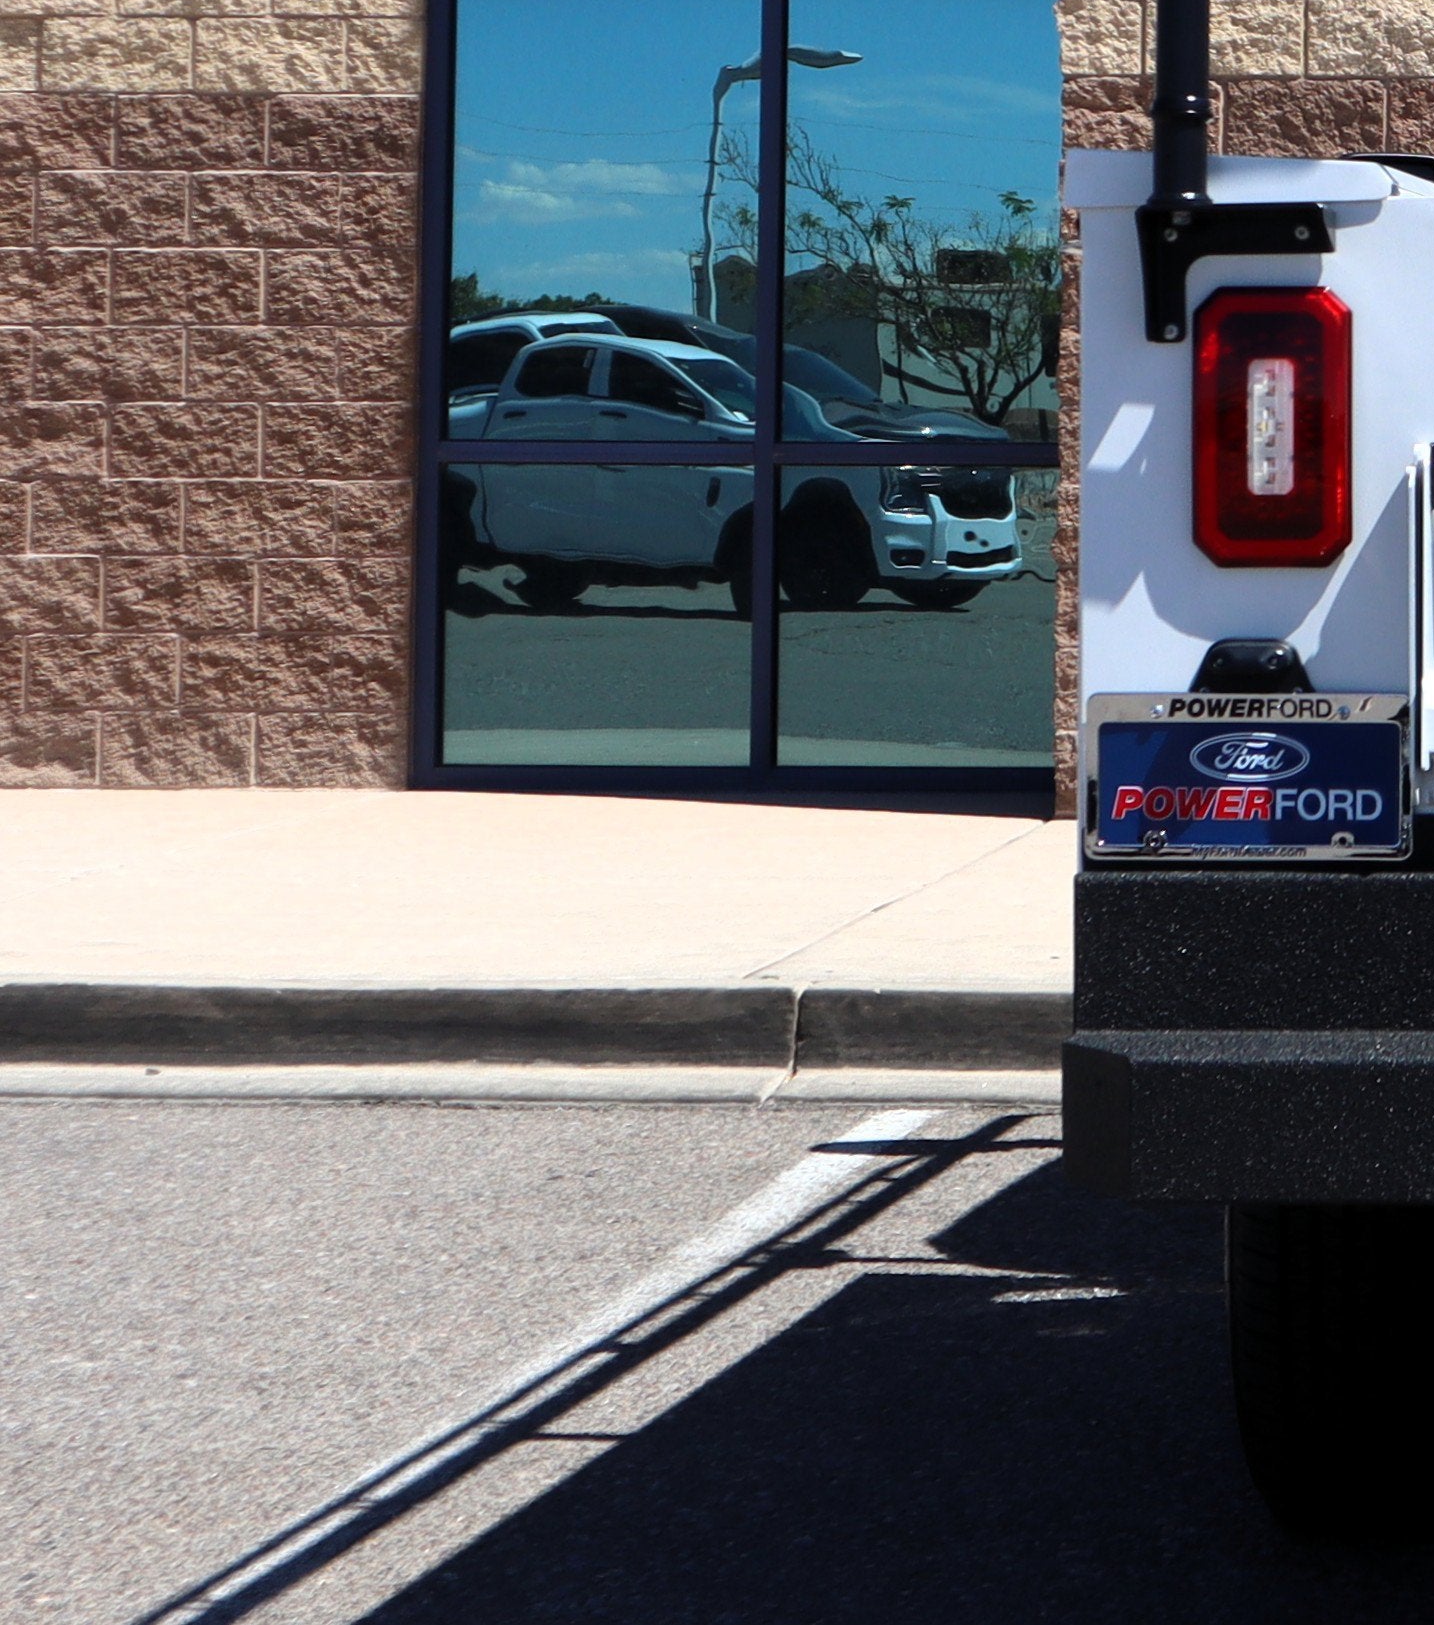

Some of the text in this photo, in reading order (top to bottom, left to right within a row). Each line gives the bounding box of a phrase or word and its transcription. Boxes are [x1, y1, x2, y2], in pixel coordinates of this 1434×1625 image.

[1168, 698, 1332, 718] POWERFORD
[1213, 741, 1284, 771] Ford
[1112, 786, 1383, 820] POWERFORD
